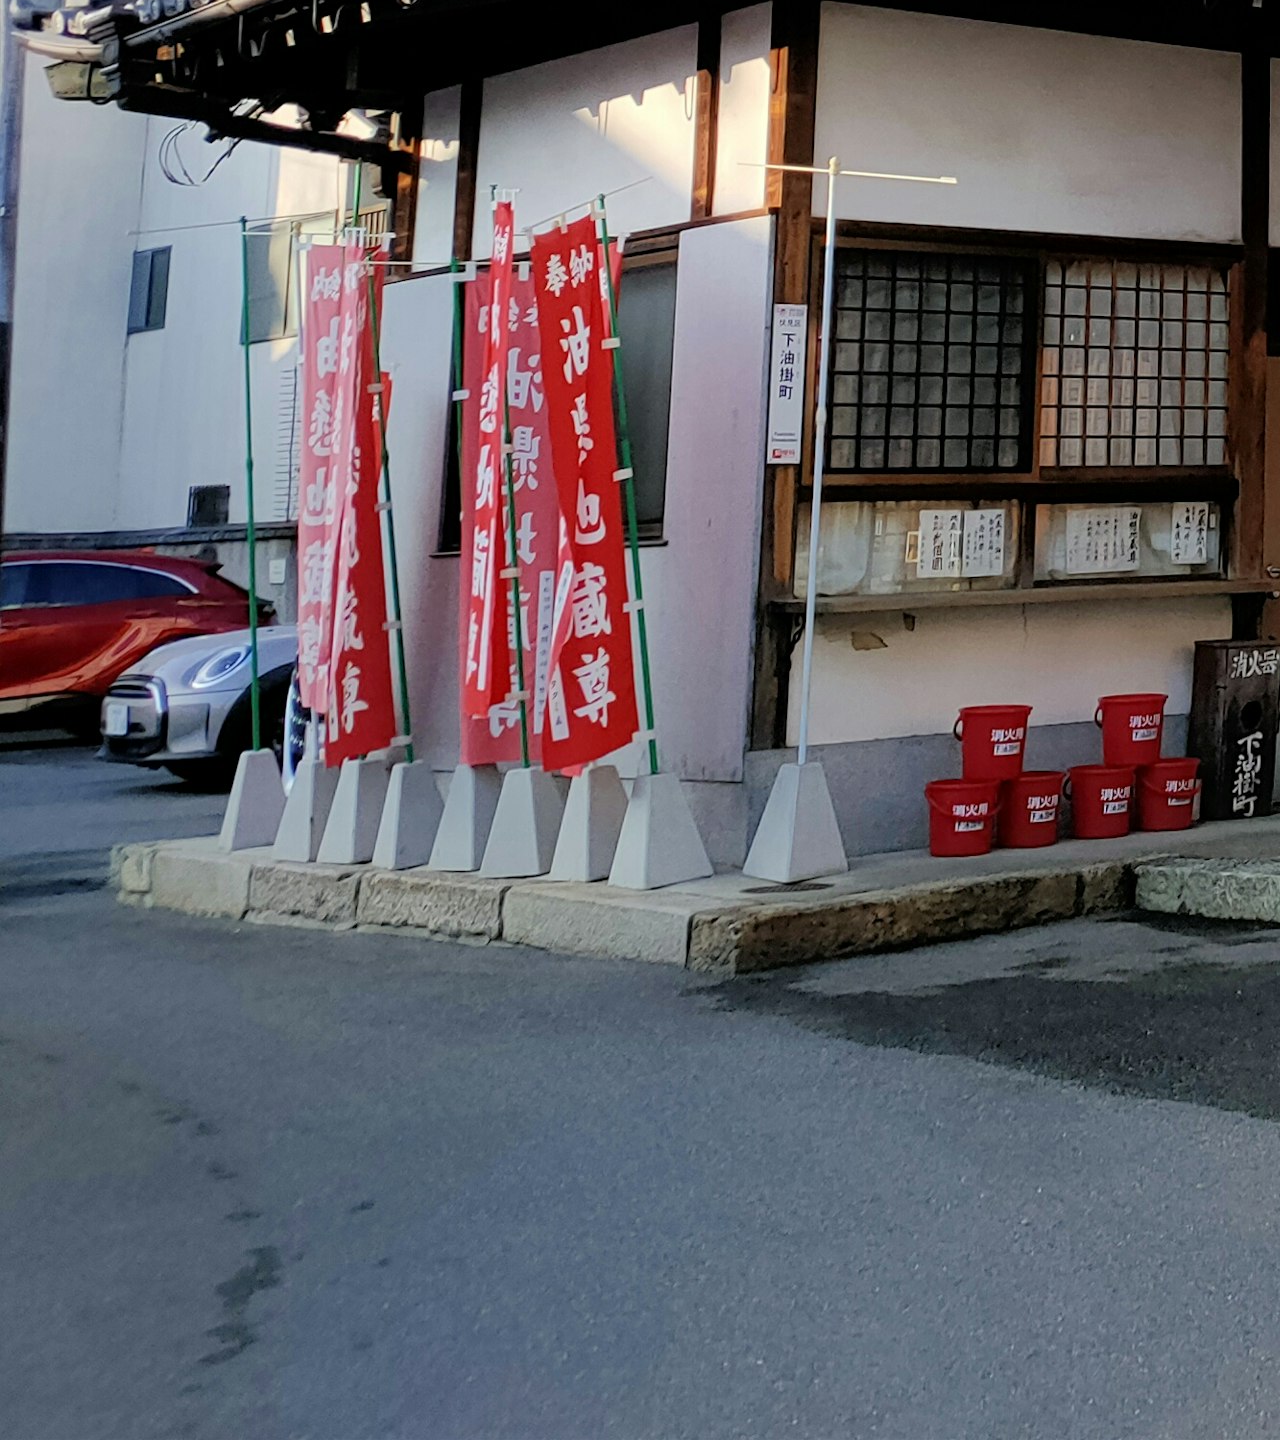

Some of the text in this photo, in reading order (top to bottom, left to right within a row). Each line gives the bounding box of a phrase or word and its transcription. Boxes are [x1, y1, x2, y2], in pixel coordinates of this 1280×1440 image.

[545, 244, 594, 297] 奉納
[779, 332, 796, 400] 下油掛町
[1230, 649, 1280, 679] 消火器
[1232, 731, 1264, 818] 下油掛町
